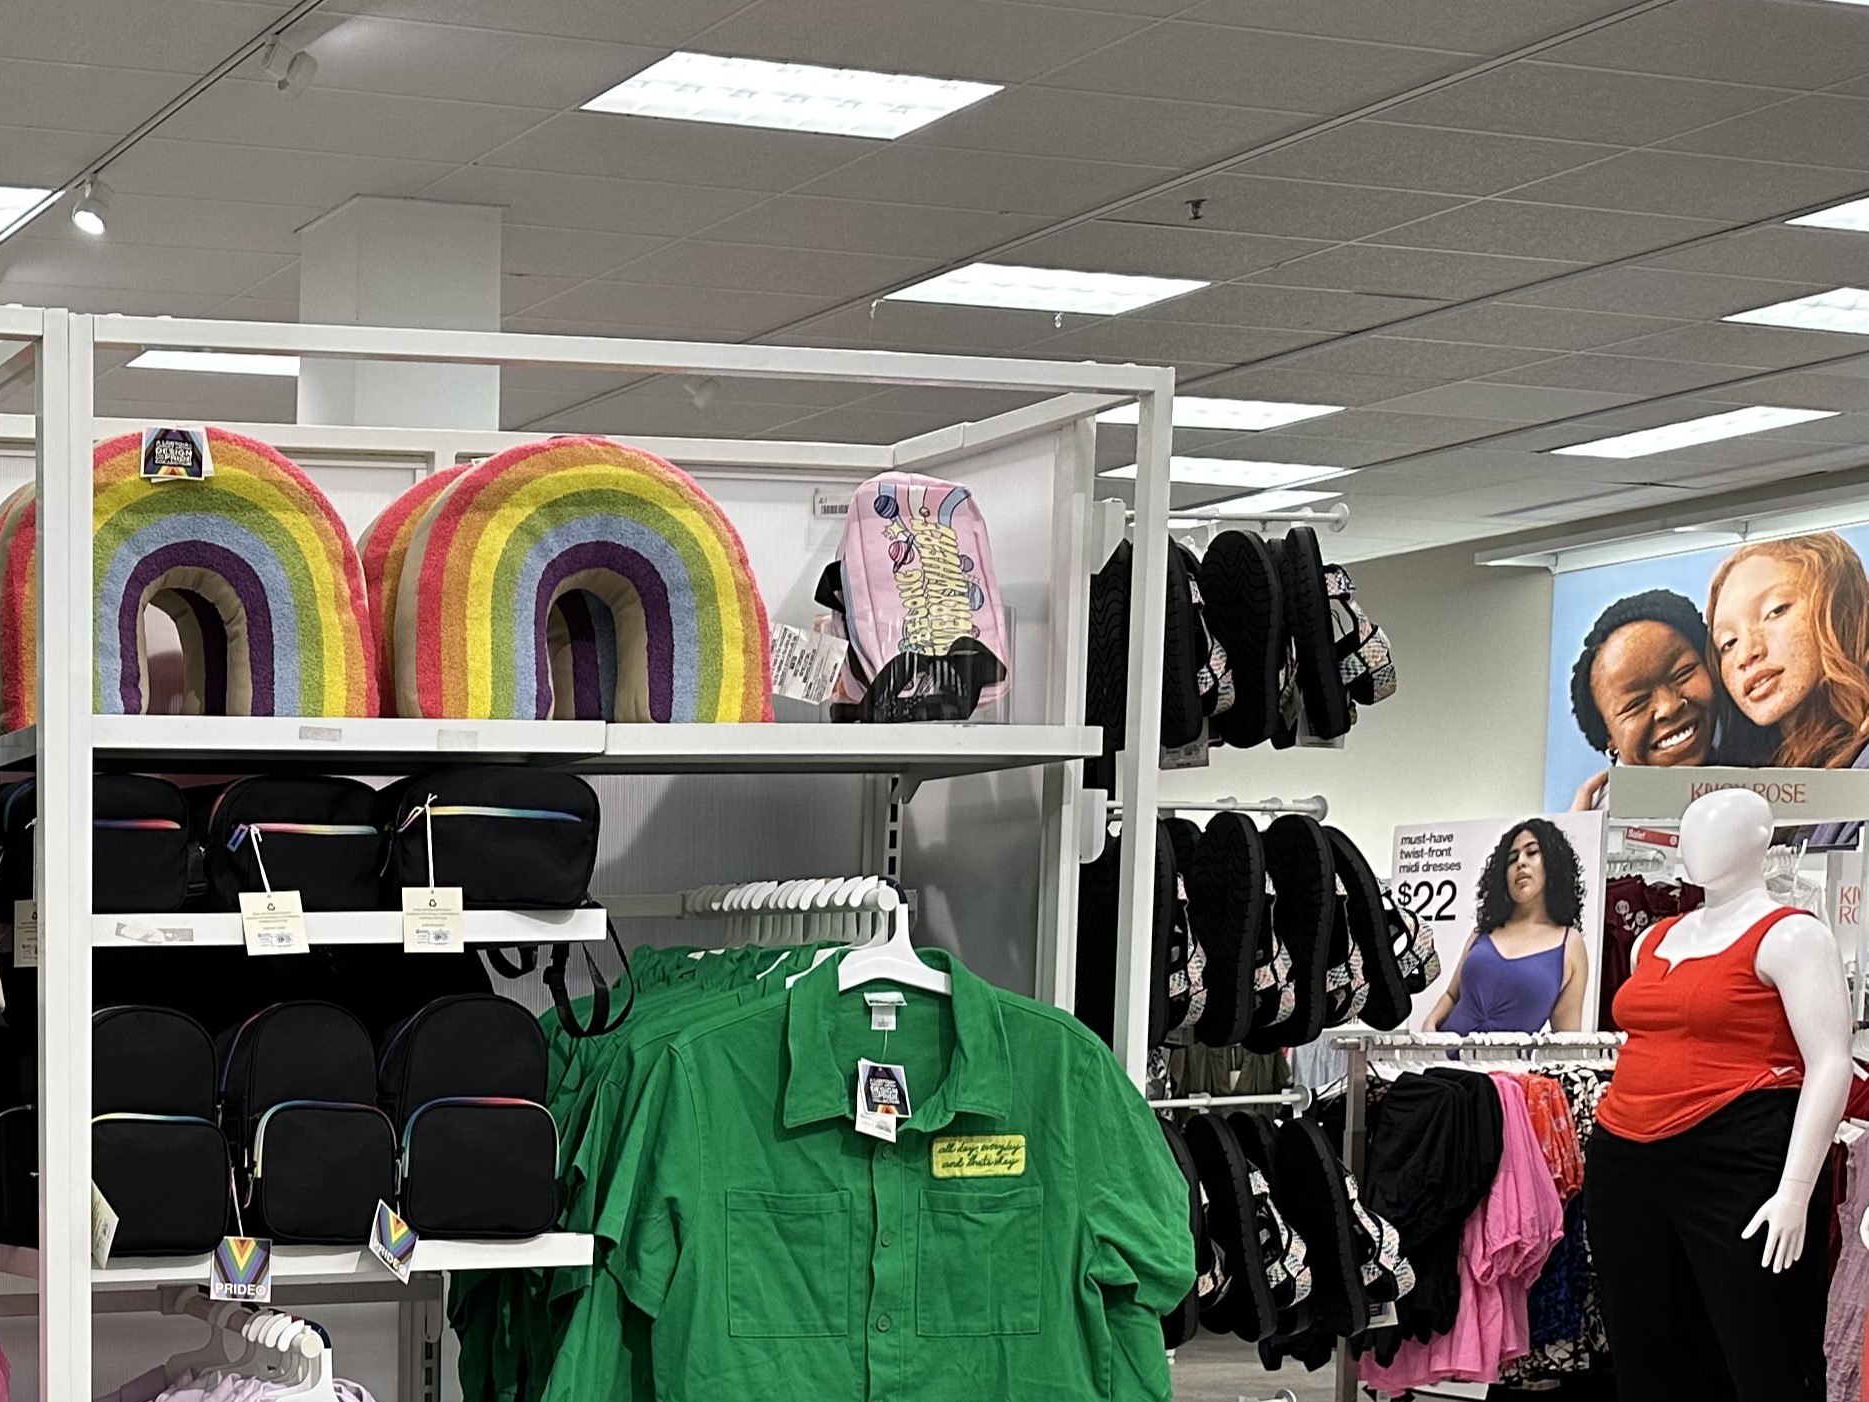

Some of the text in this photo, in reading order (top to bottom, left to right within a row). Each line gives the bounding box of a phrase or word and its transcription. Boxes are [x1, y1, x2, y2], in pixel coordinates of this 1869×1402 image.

[1753, 783, 1806, 803] ROSE
[1401, 832, 1453, 845] must-have
[1400, 846, 1452, 859] twist-front
[1399, 861, 1461, 873] midi dresses
[1398, 880, 1457, 921] $22
[372, 1239, 401, 1271] PRIDE
[215, 1282, 256, 1296] PRIDE
